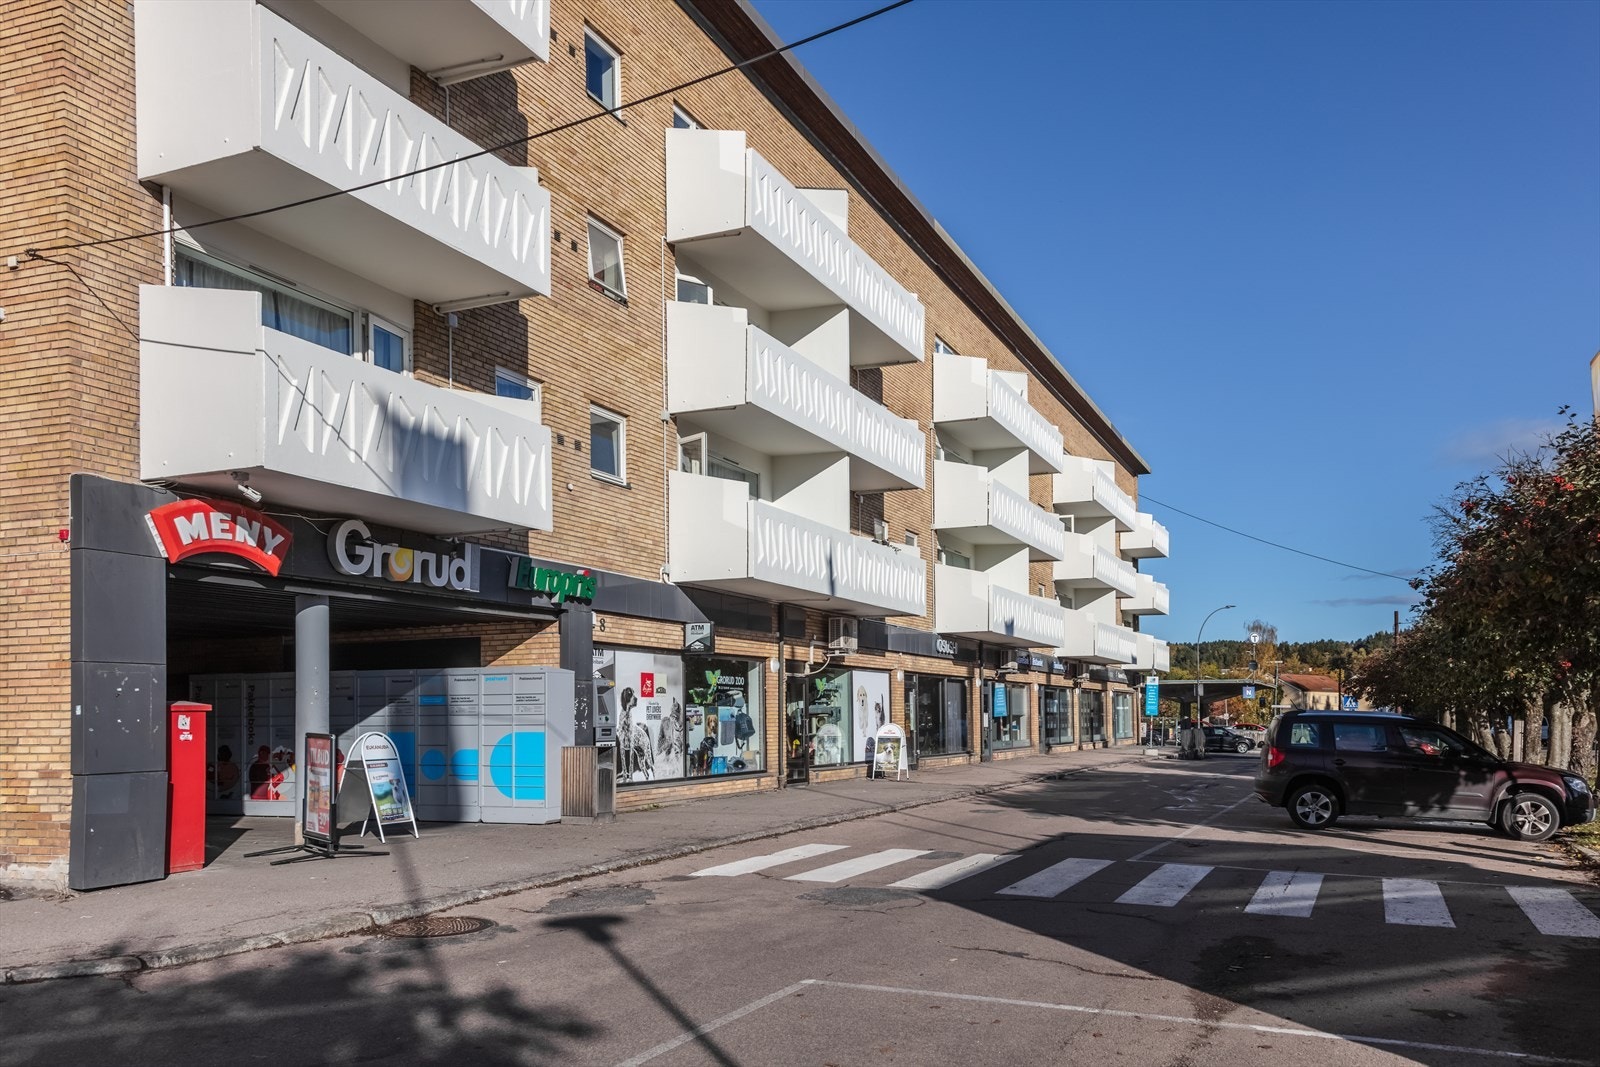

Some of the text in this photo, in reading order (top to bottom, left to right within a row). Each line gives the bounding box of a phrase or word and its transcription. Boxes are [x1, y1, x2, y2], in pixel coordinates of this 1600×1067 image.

[174, 512, 285, 555] MENY
[330, 520, 477, 592] Grorud
[599, 618, 606, 632] 8
[717, 675, 745, 686] GRORUD ZOO
[310, 747, 329, 765] TILBUD
